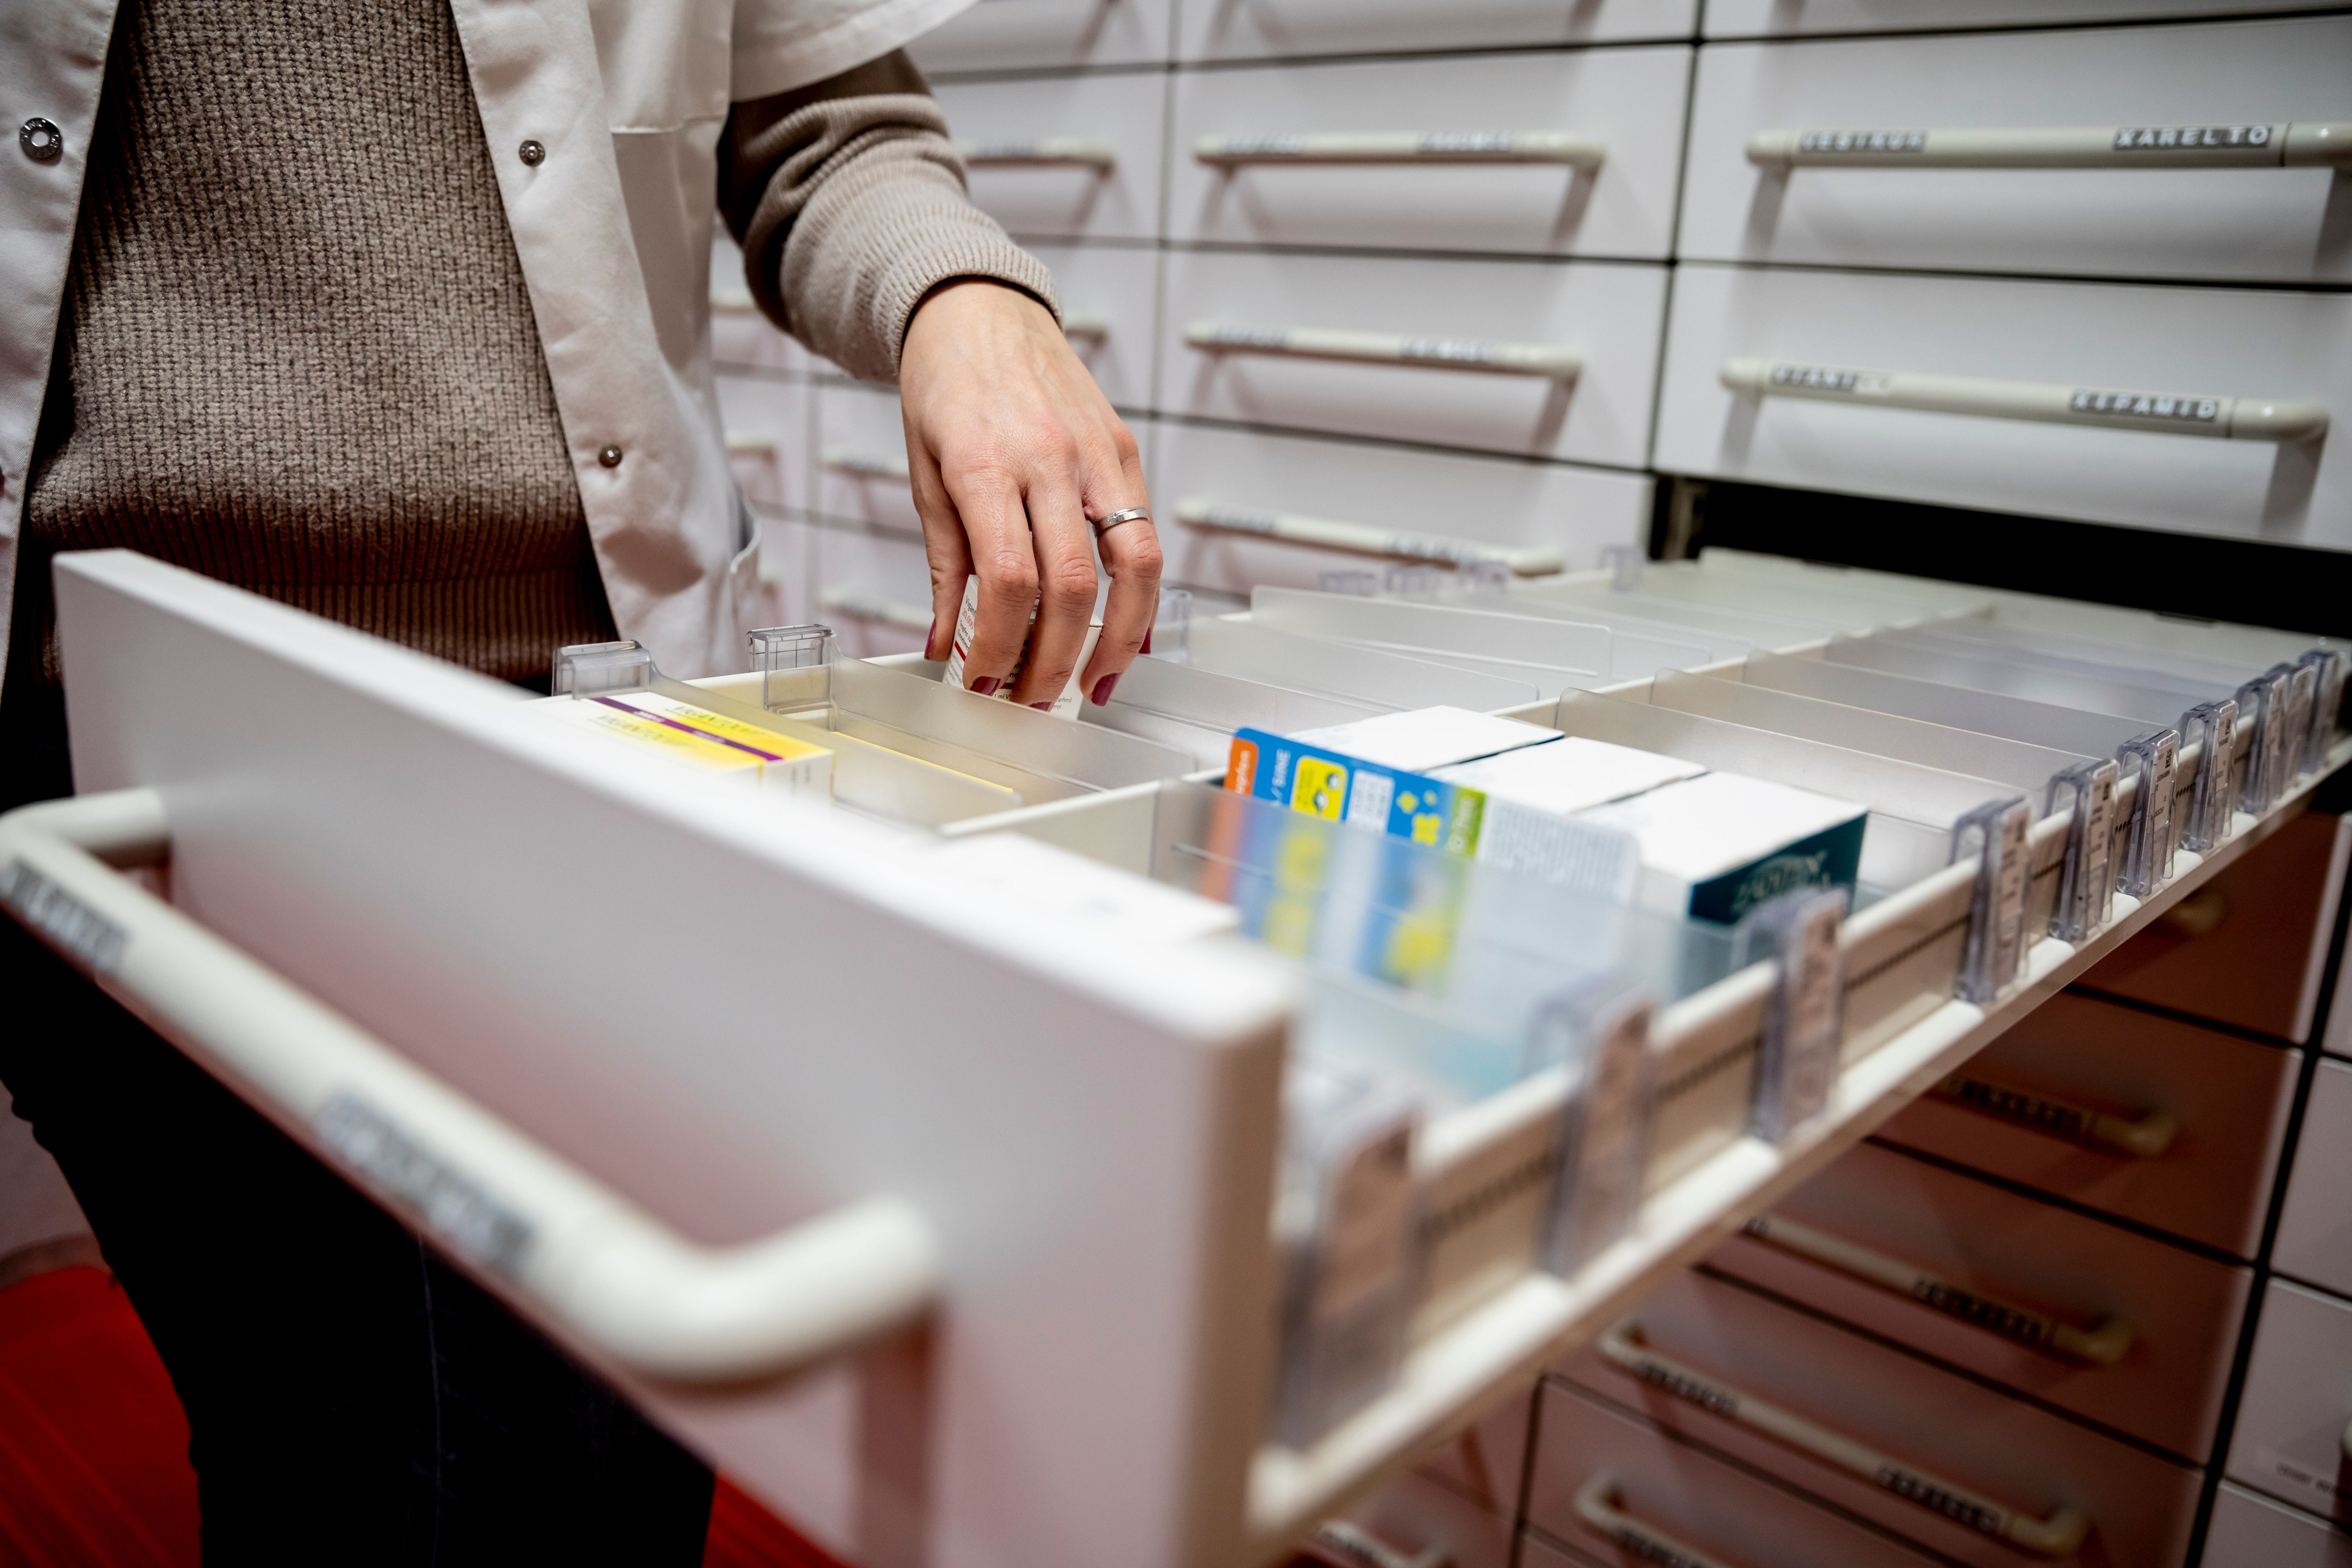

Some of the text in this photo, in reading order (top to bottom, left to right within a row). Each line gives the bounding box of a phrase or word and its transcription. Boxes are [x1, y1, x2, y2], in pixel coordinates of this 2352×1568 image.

[2117, 125, 2270, 147] XARELTO
[965, 595, 976, 618] Vigant
[959, 620, 968, 637] Tropfen
[962, 608, 974, 630] 20.000
[957, 629, 969, 650] Einnehme
